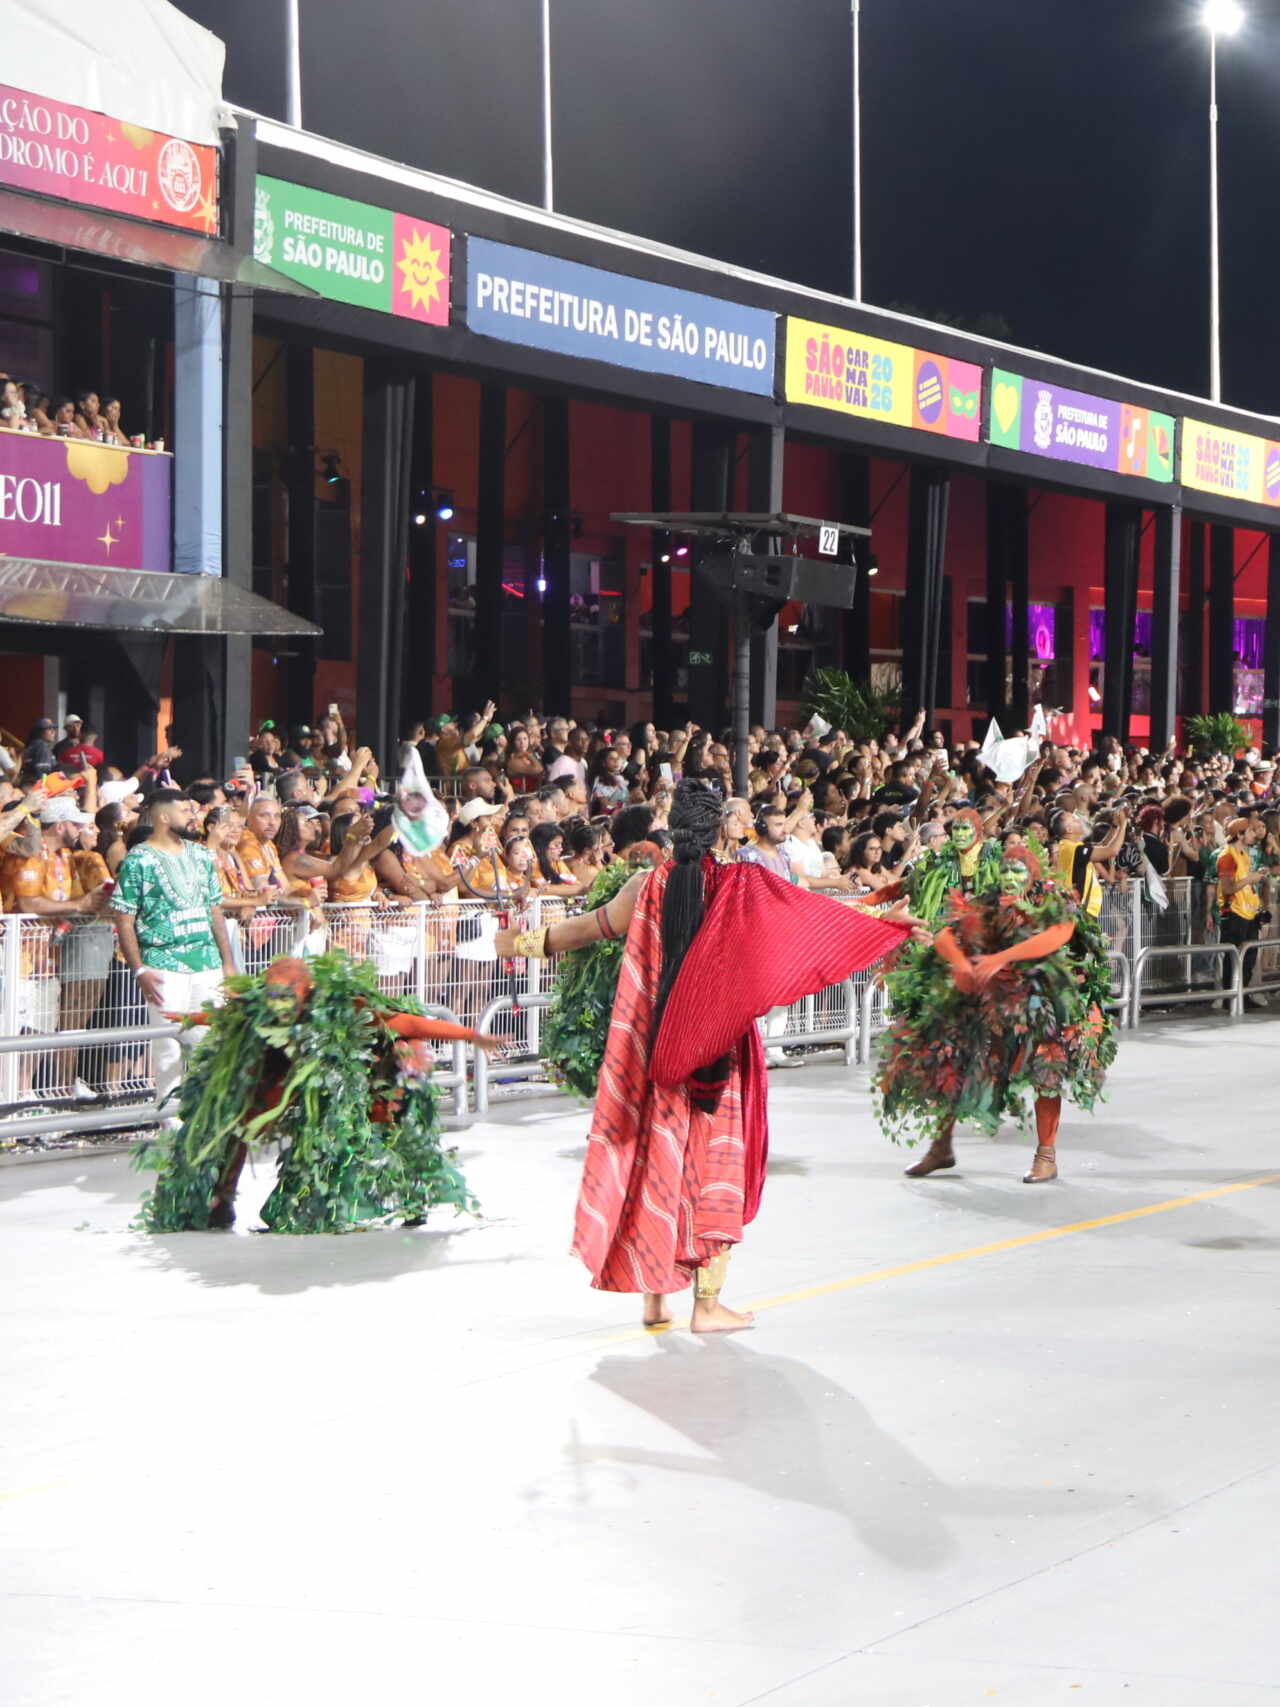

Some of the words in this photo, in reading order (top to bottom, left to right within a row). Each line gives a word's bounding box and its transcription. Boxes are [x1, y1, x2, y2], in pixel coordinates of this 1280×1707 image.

[0, 98, 52, 135] ÇÃO
[57, 112, 90, 145] DO
[83, 152, 95, 183] É
[99, 161, 149, 197] AQUI
[284, 209, 365, 248] PREFEITURA
[367, 231, 385, 254] DE
[283, 234, 322, 269] SÃO
[325, 247, 385, 284] PAULO
[476, 272, 619, 340] PREFEITURA
[624, 308, 653, 347] DE
[657, 314, 699, 356] SÃO
[704, 326, 767, 371] PAULO
[805, 333, 845, 378] SÃO
[846, 346, 869, 369] CAR
[871, 353, 893, 382] 20
[805, 372, 843, 401] PAULO
[845, 385, 868, 408] VAL
[870, 382, 893, 413] 26
[1055, 421, 1076, 446] SÃO
[1076, 428, 1108, 453] PAULO
[823, 529, 837, 552] 22
